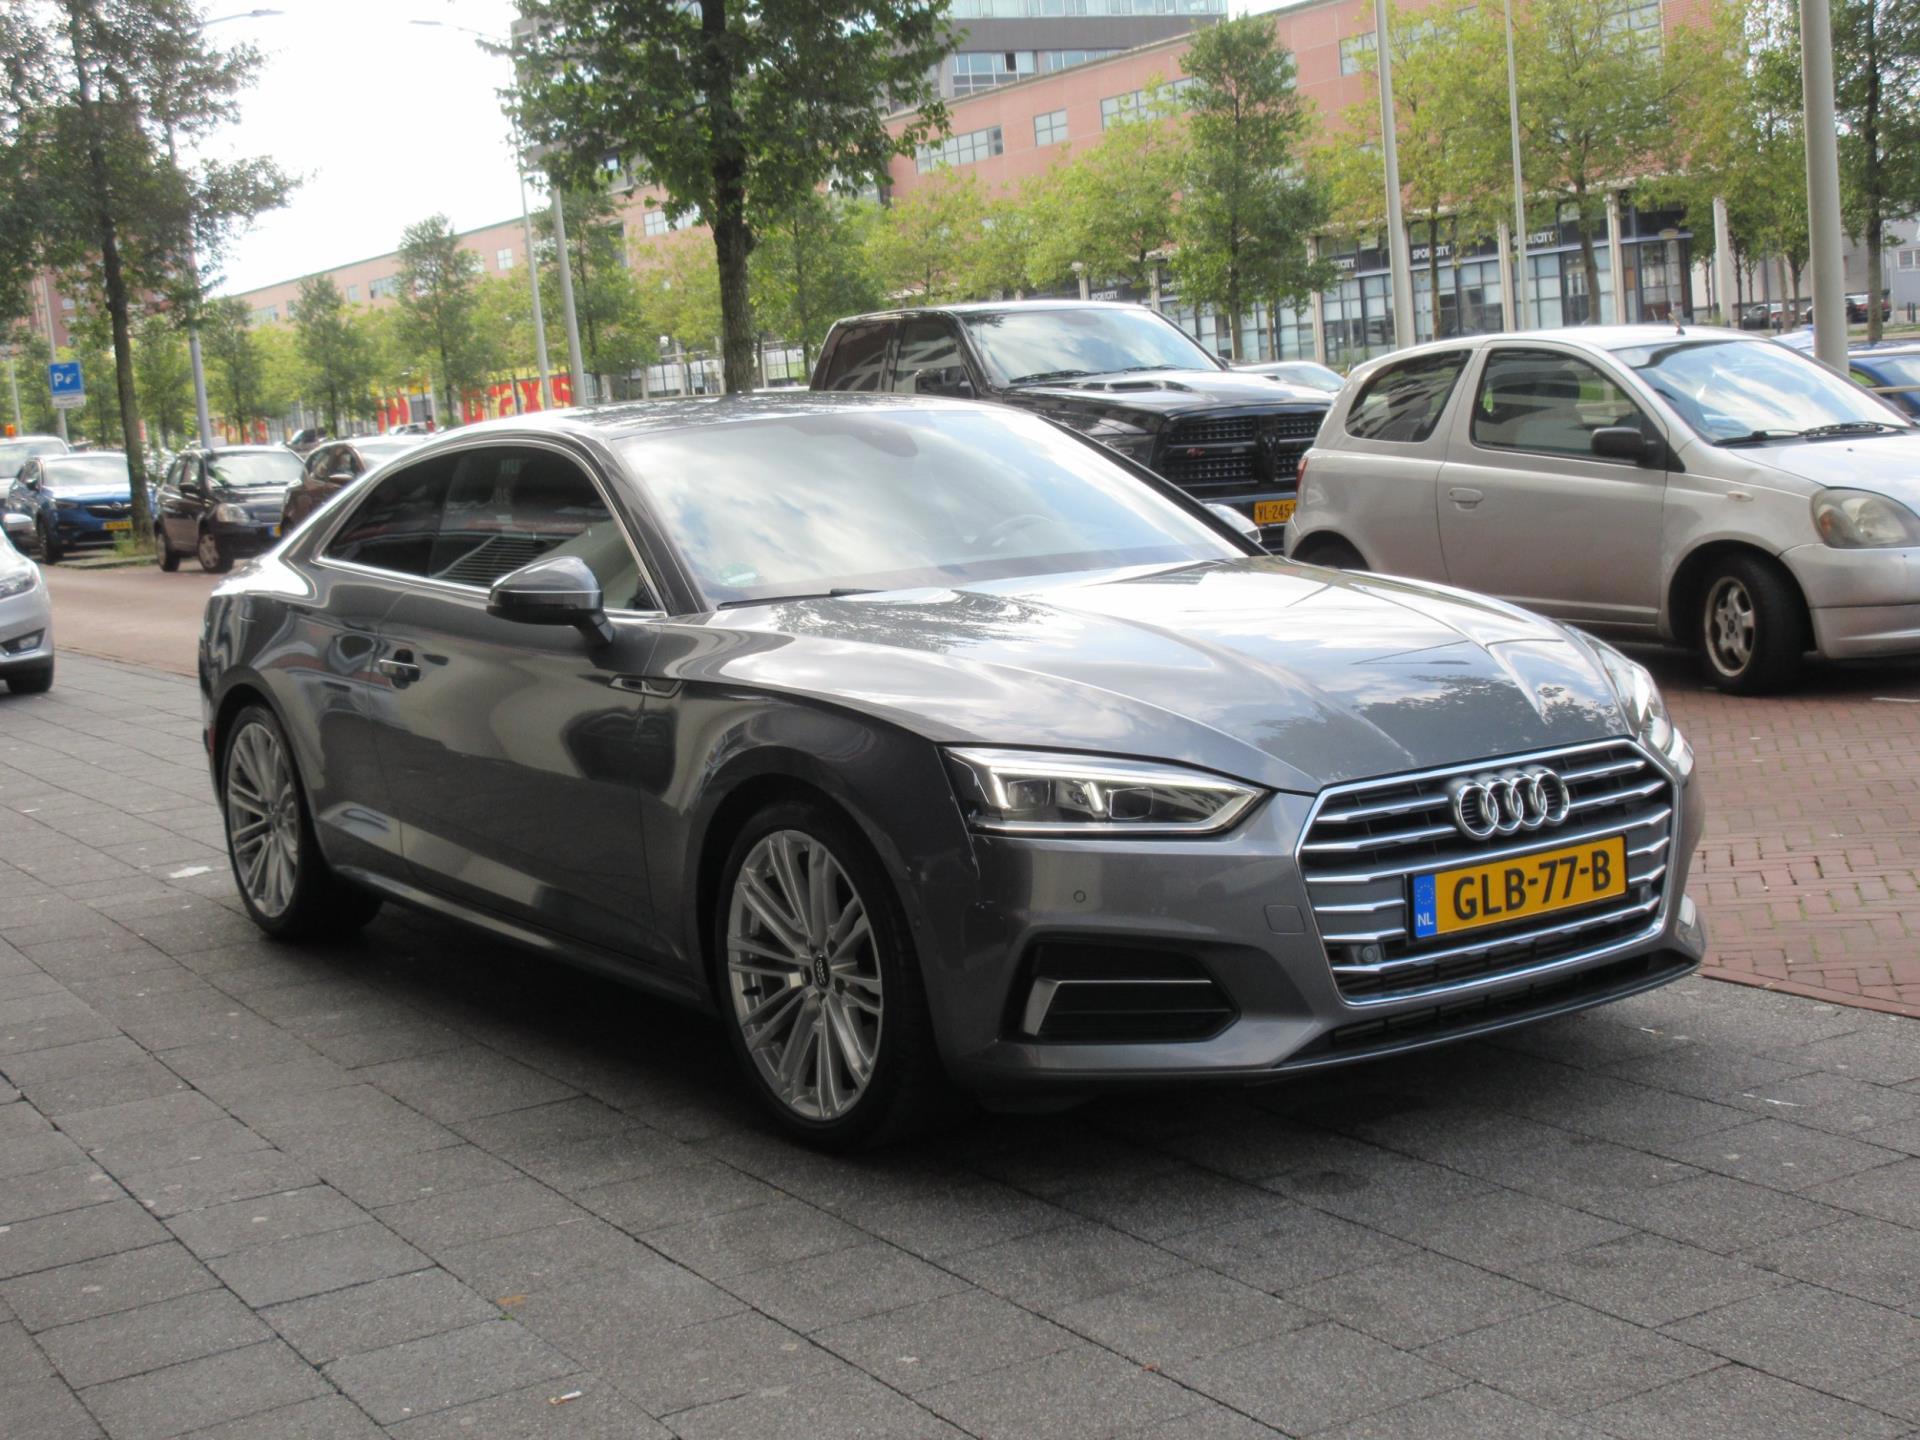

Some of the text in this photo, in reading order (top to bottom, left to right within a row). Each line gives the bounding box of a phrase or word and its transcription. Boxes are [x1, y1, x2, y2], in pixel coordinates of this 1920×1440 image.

[53, 372, 64, 387] P
[1453, 849, 1612, 921] GLB-77-B
[1417, 912, 1434, 926] NL
